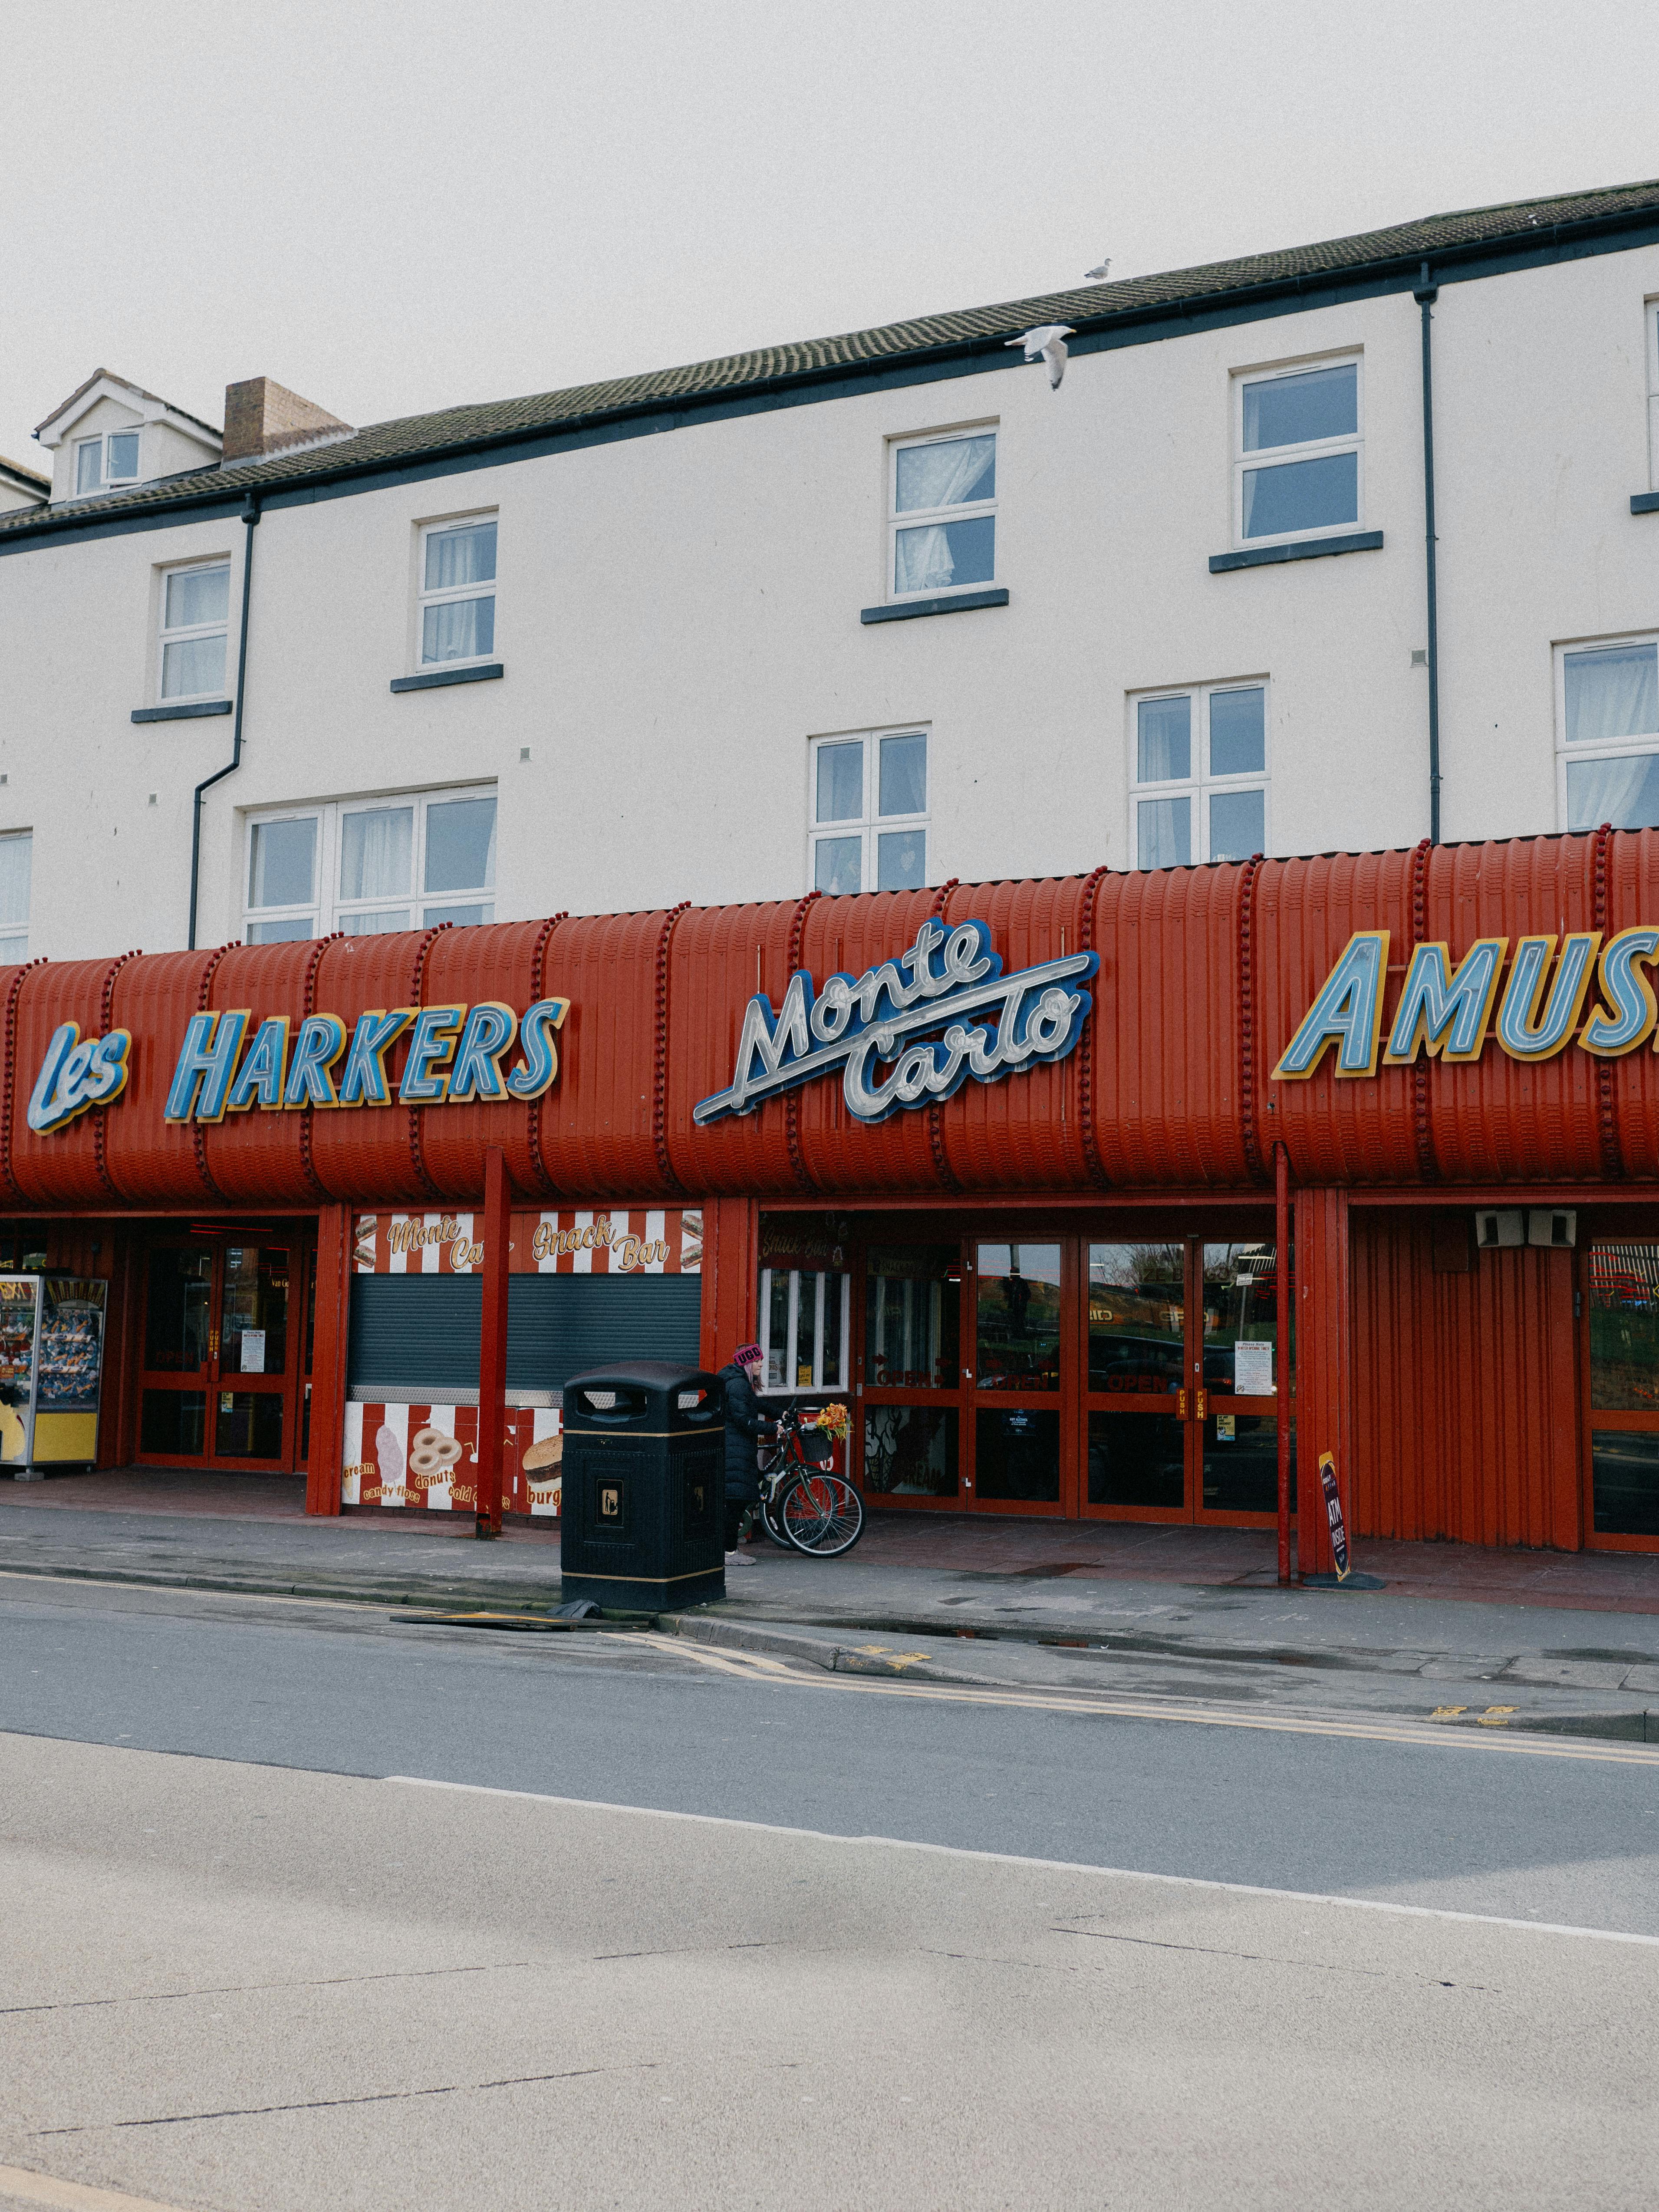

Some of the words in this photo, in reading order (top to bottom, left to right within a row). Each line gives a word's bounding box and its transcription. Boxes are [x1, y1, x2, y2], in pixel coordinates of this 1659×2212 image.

[731, 918, 992, 1109] Monte
[1271, 926, 1659, 1080] AMUS
[164, 997, 571, 1124] HARKERS
[844, 986, 1082, 1120] Carlo
[388, 1215, 462, 1254] Monte
[533, 1215, 616, 1261] Snack
[613, 1234, 671, 1271] Bar
[156, 1351, 194, 1364] OPEN
[738, 1347, 761, 1364] UGG
[877, 1369, 931, 1387] OPEN
[992, 1373, 1049, 1389] OPEN
[1108, 1375, 1168, 1392] OPEN
[344, 1463, 375, 1478] cream
[415, 1472, 456, 1489] donuts
[364, 1487, 393, 1500] candy
[396, 1485, 420, 1503] floss
[448, 1485, 472, 1503] cold
[527, 1485, 561, 1507] burg
[1327, 1497, 1342, 1527] ATM
[1331, 1525, 1345, 1547] INSIDE
